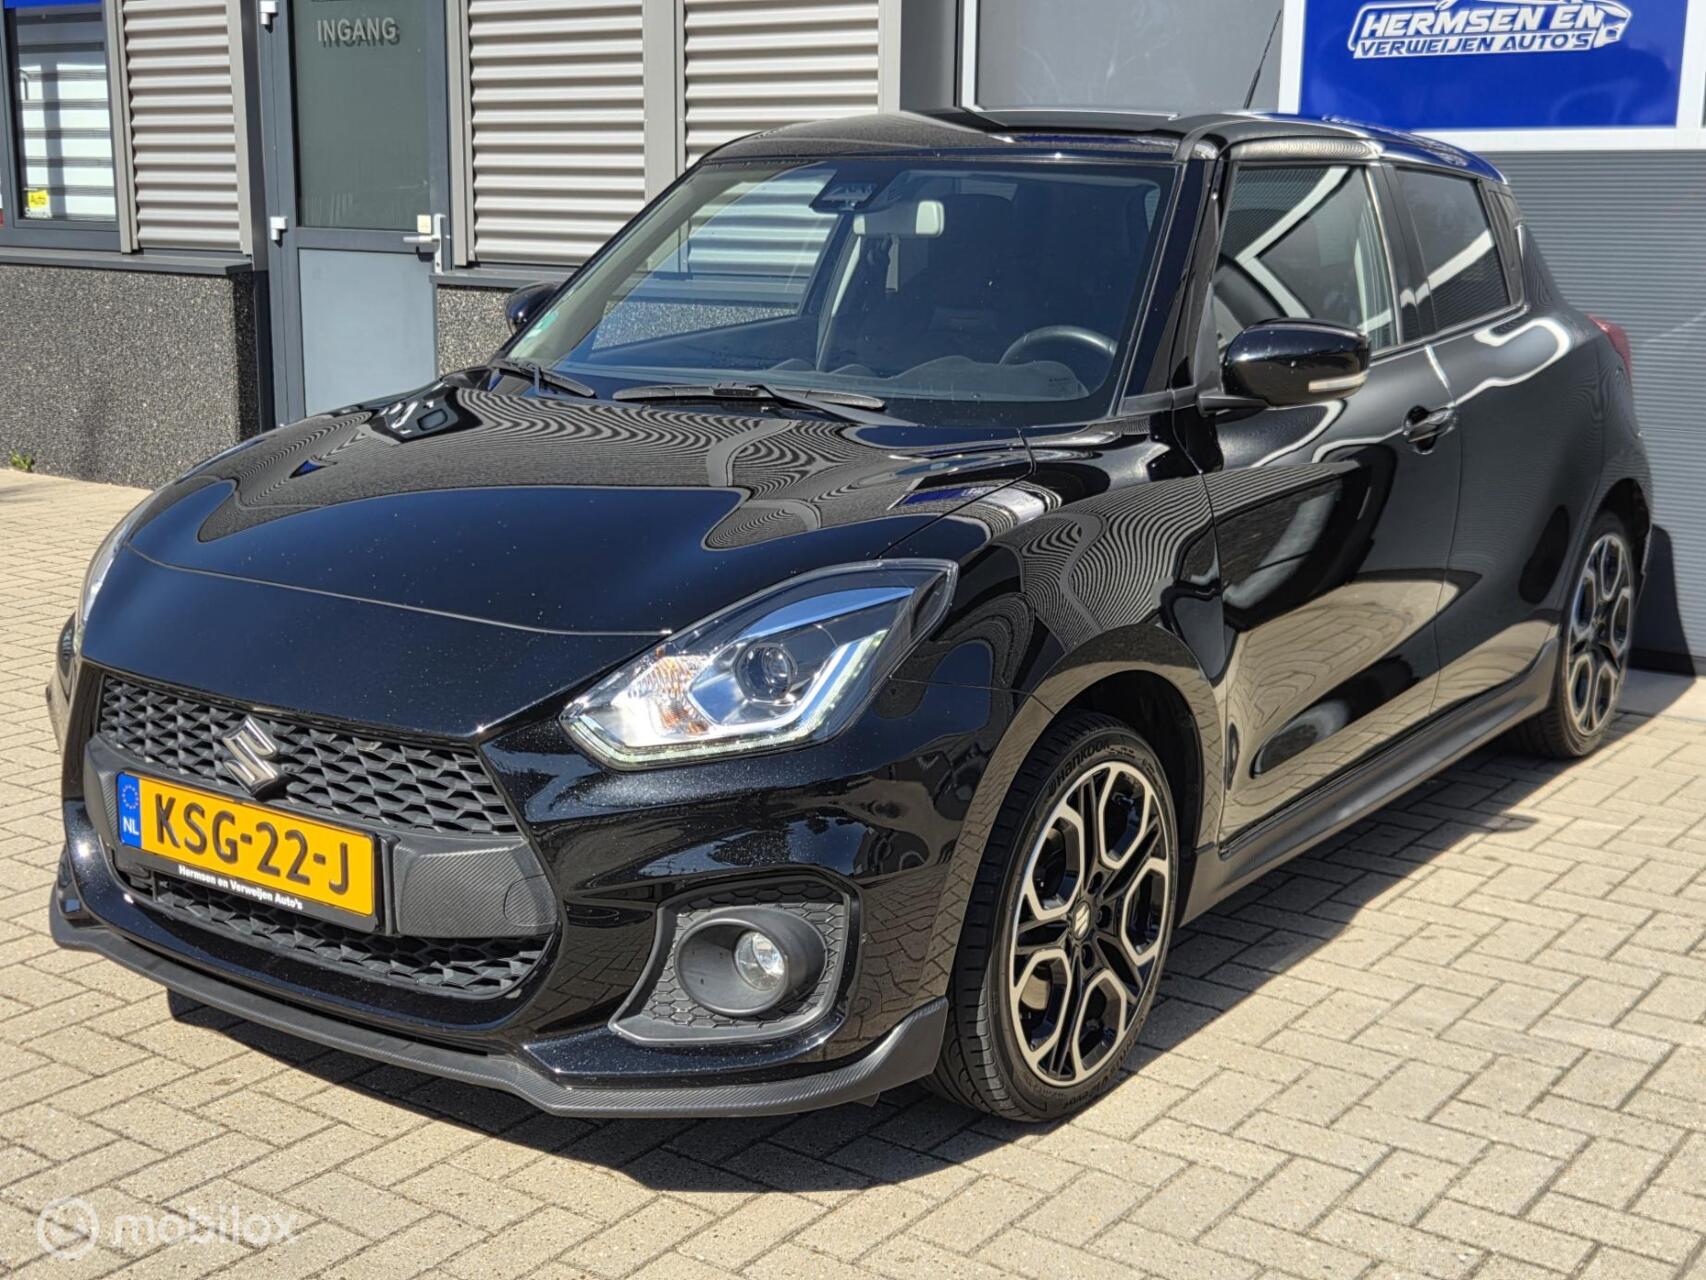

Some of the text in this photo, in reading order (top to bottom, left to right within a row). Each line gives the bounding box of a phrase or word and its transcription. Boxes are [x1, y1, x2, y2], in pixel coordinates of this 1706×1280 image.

[317, 17, 397, 43] INGANG
[1360, 4, 1606, 38] HERMSEN EN
[1360, 32, 1593, 56] VERWEIJEN AUTO'S
[123, 816, 139, 836] NL
[155, 793, 349, 895] KSG-22-J
[178, 864, 303, 910] Hermsen en Verweijen Auto's
